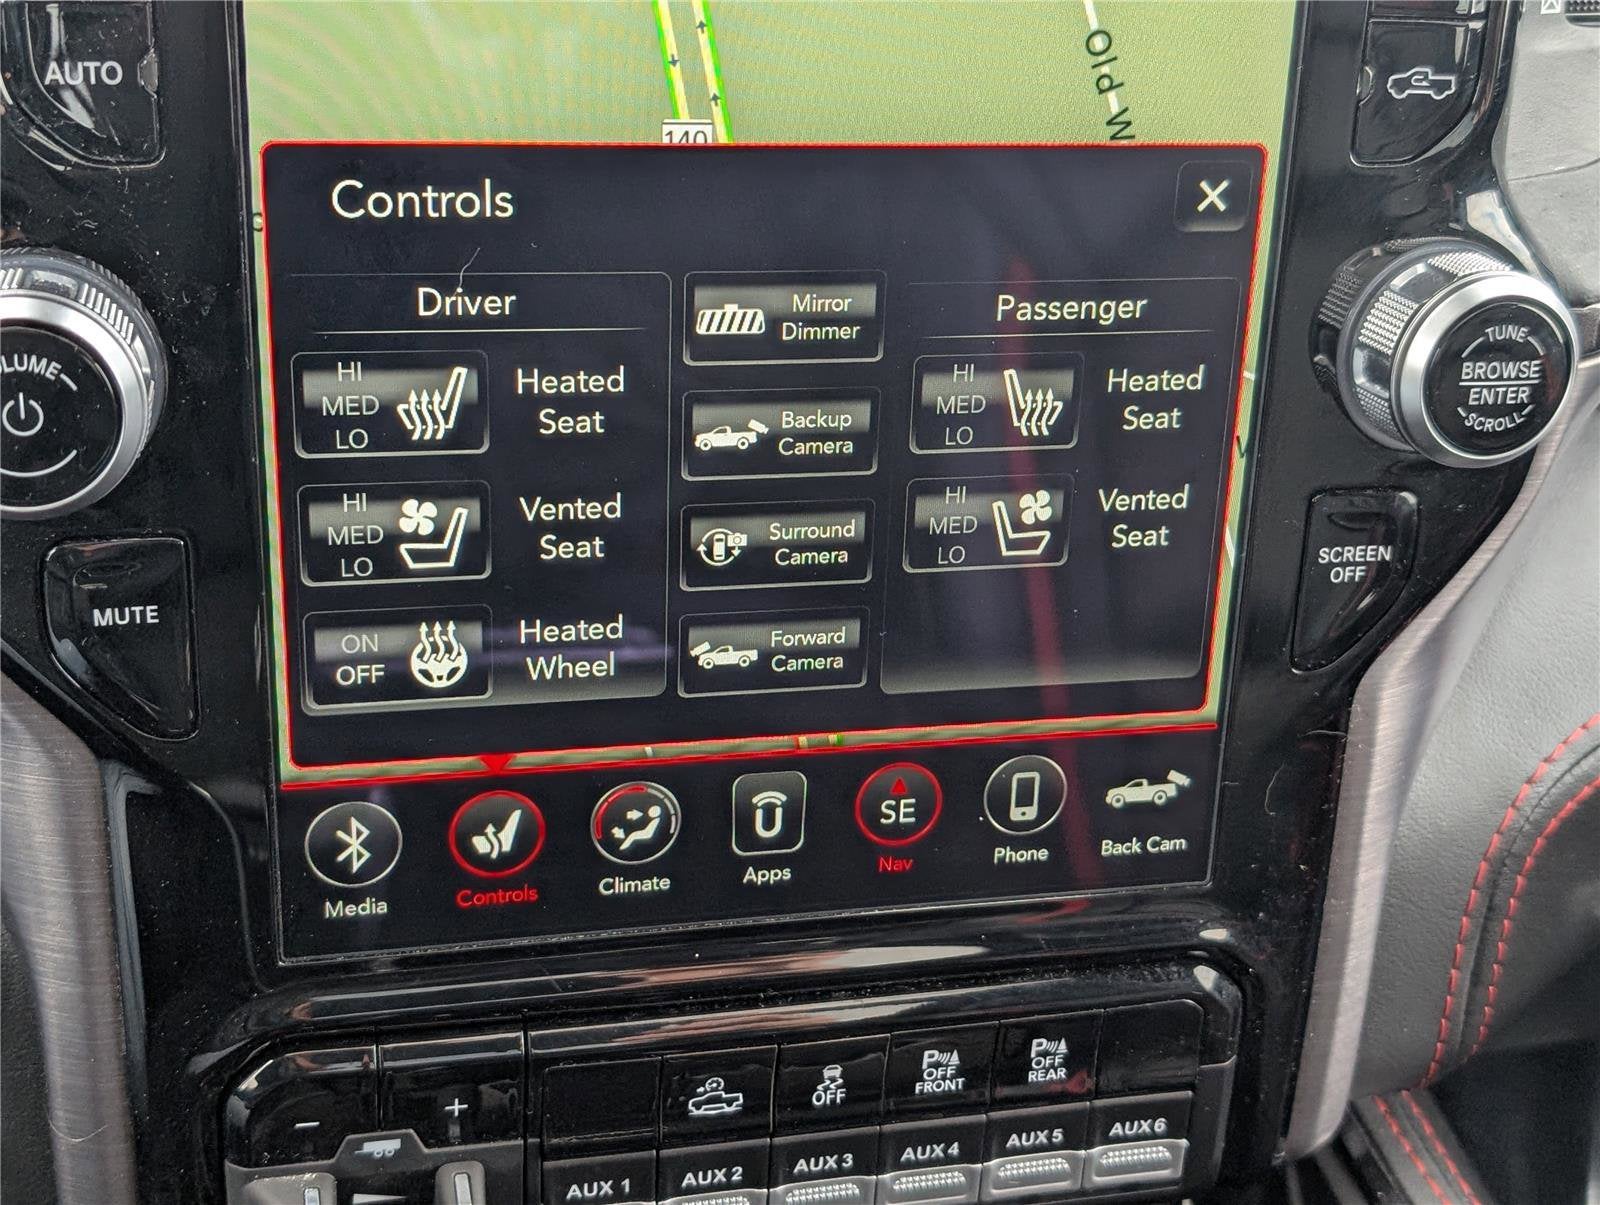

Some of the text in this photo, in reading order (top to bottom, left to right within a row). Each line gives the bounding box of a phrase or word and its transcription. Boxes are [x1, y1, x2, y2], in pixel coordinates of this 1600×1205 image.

[1085, 29, 1124, 95] Old
[44, 58, 124, 88] AUTO
[331, 178, 514, 219] Controls
[417, 288, 517, 317] Driver
[792, 293, 853, 313] Mirror
[996, 294, 1148, 326] Passenger
[781, 321, 861, 341] Dimmer
[1485, 324, 1528, 342] TUNE
[0, 353, 62, 380] LUME
[337, 361, 362, 382] HI
[953, 363, 975, 383] HI
[1461, 360, 1541, 379] BROWSE
[517, 364, 625, 395] Heated
[1107, 364, 1205, 393] Heated
[322, 395, 380, 417] MED
[936, 394, 987, 415] MED
[1468, 387, 1530, 405] ENTER
[539, 407, 605, 435] Seat
[781, 408, 852, 432] Backup
[1122, 405, 1182, 431] Seat
[1464, 412, 1526, 432] SCROLL
[335, 428, 369, 450] LO
[945, 425, 974, 446] LO
[778, 437, 854, 456] Camera
[342, 492, 367, 513] HI
[945, 485, 967, 505] HI
[1098, 483, 1190, 512] Vented
[519, 491, 622, 522] Vented
[327, 525, 384, 546] MED
[769, 518, 856, 541] Surround
[929, 515, 978, 535] MED
[1111, 523, 1170, 549] Seat
[540, 534, 605, 560] Seat
[774, 547, 849, 566] Camera
[937, 545, 966, 565] LO
[1317, 545, 1392, 564] SCREEN
[340, 556, 374, 578] LO
[1329, 565, 1367, 584] OFF
[92, 605, 160, 627] MUTE
[519, 613, 624, 644] Heated
[770, 625, 846, 648] Forward
[340, 633, 379, 654] ON
[525, 651, 615, 681] Wheel
[771, 654, 844, 673] Camera
[335, 664, 386, 686] OFF
[879, 798, 916, 825] SE
[993, 845, 1050, 865] Phone
[1100, 835, 1188, 857] Back Cam
[878, 856, 914, 872] Nav
[598, 876, 671, 896] Climate
[742, 866, 792, 886] Apps
[455, 883, 539, 909] Controls
[324, 896, 388, 919] Media
[1032, 1054, 1064, 1069] OFF
[923, 1067, 957, 1081] OFF
[1028, 1067, 1066, 1082] REAR
[915, 1078, 965, 1094] FRONT
[811, 1088, 847, 1106] OFF
[1109, 1118, 1153, 1135] AUX
[1006, 1128, 1064, 1147] AUX 5
[900, 1141, 960, 1161] AUX 4
[793, 1153, 854, 1173] AUX 3
[682, 1166, 743, 1187] AUX 2
[567, 1177, 630, 1198] AUX 1
